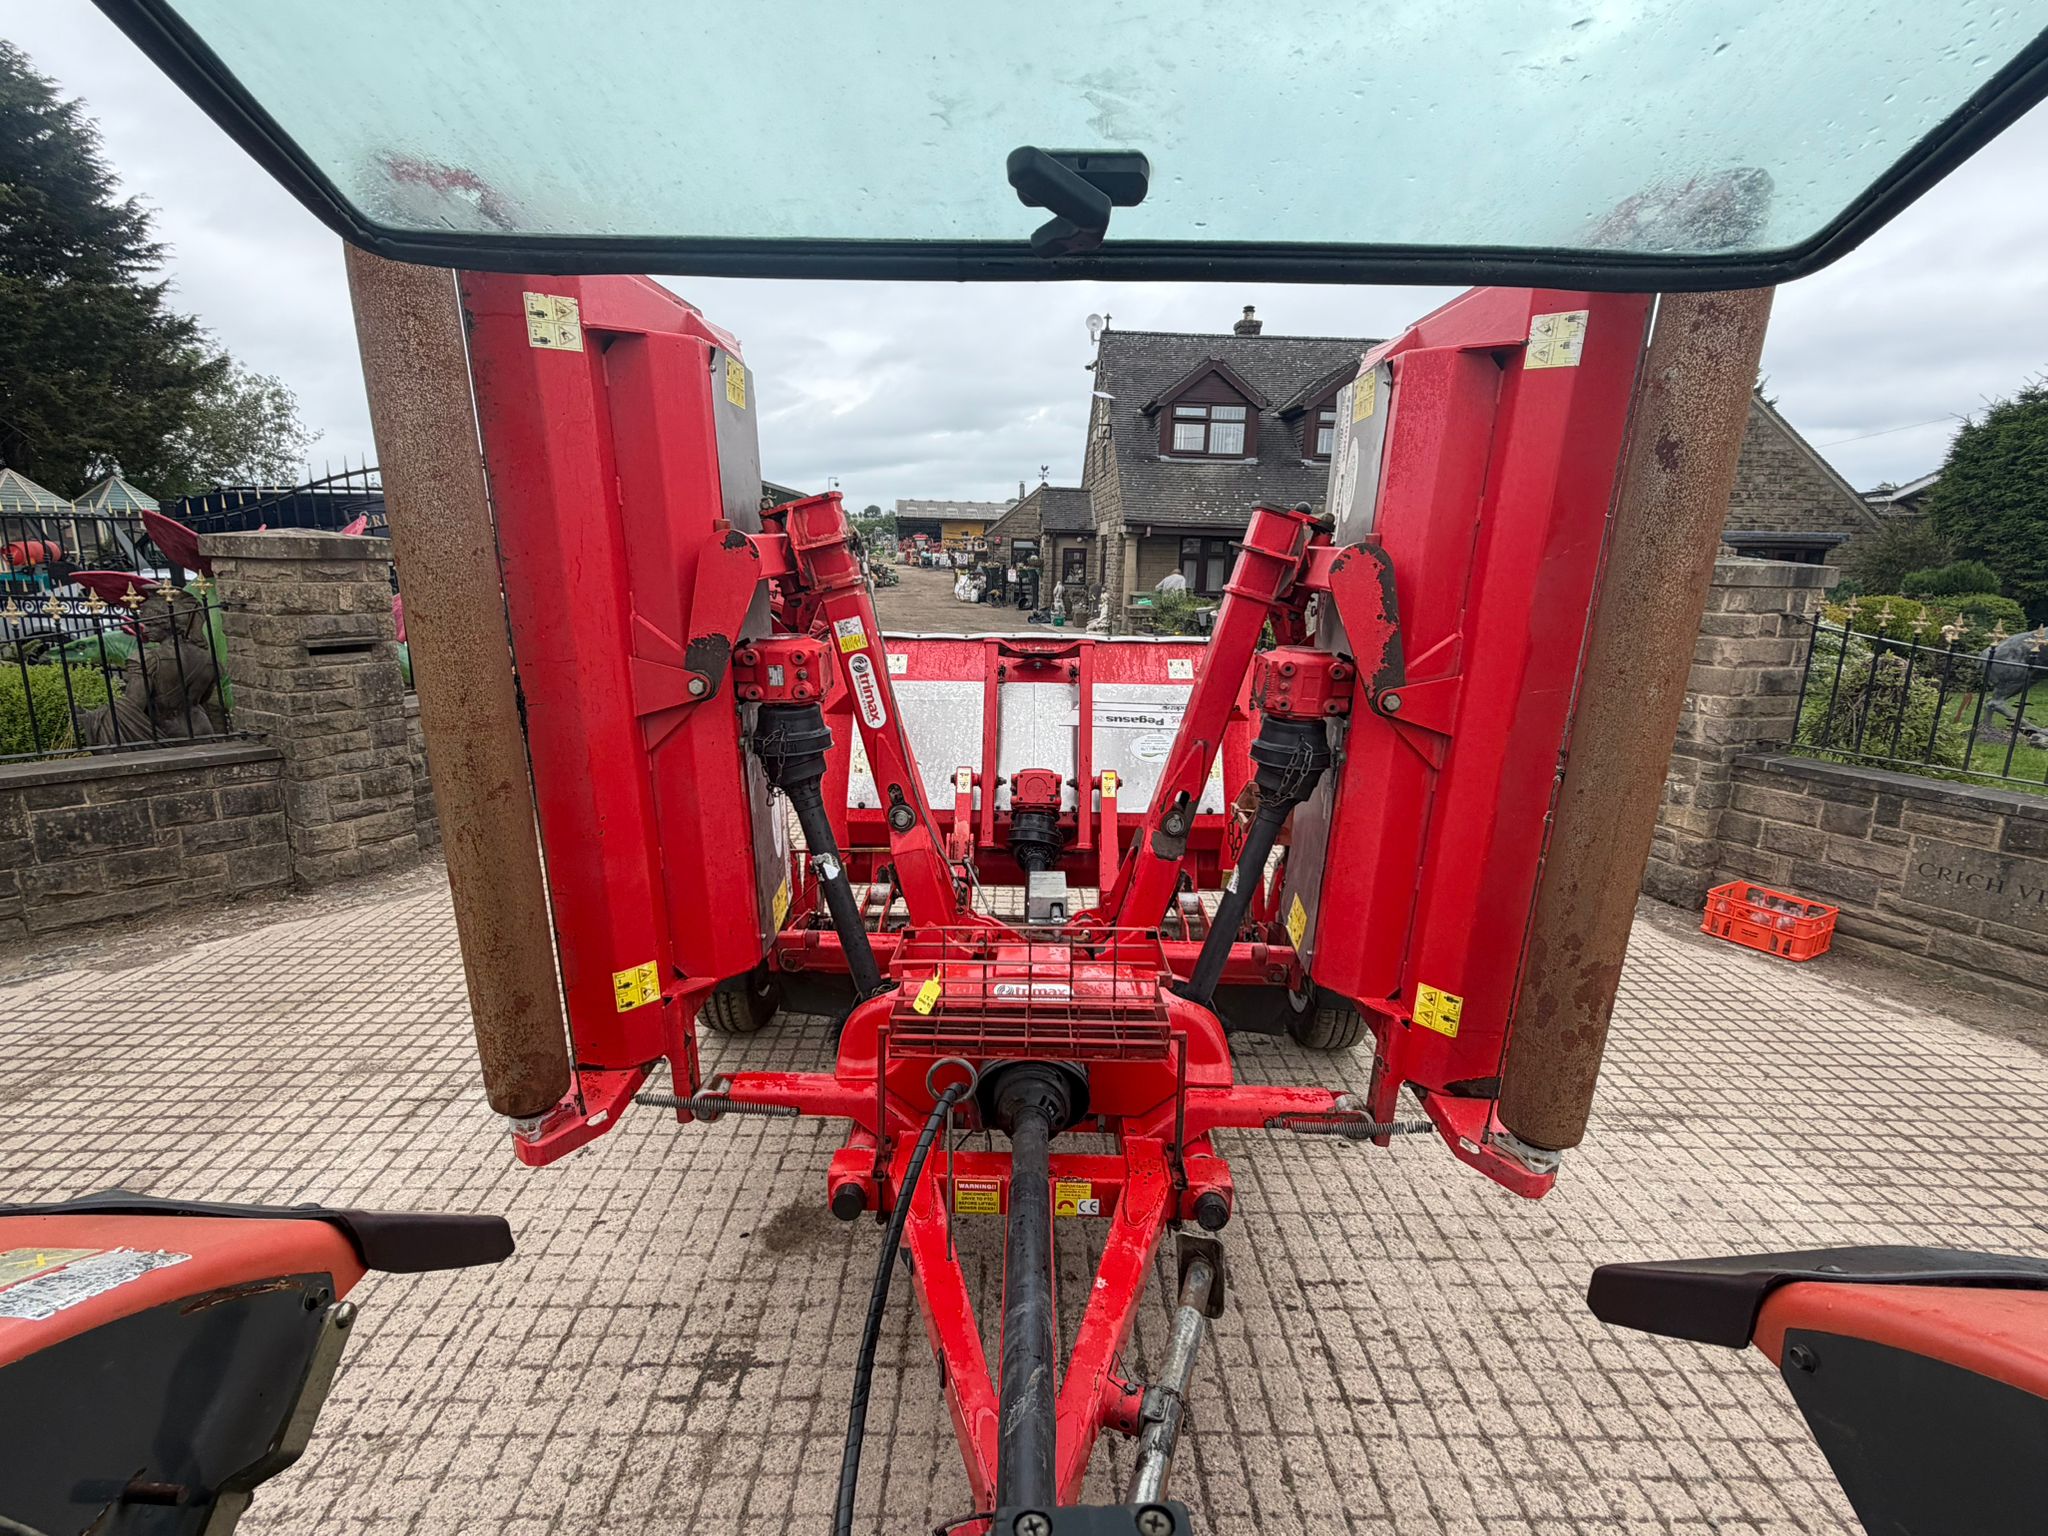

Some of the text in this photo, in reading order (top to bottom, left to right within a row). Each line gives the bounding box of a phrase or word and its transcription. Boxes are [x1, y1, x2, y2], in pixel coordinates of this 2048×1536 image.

[859, 673, 881, 722] trimax
[1106, 715, 1165, 726] Pegasus
[1918, 862, 2005, 895] CRICH
